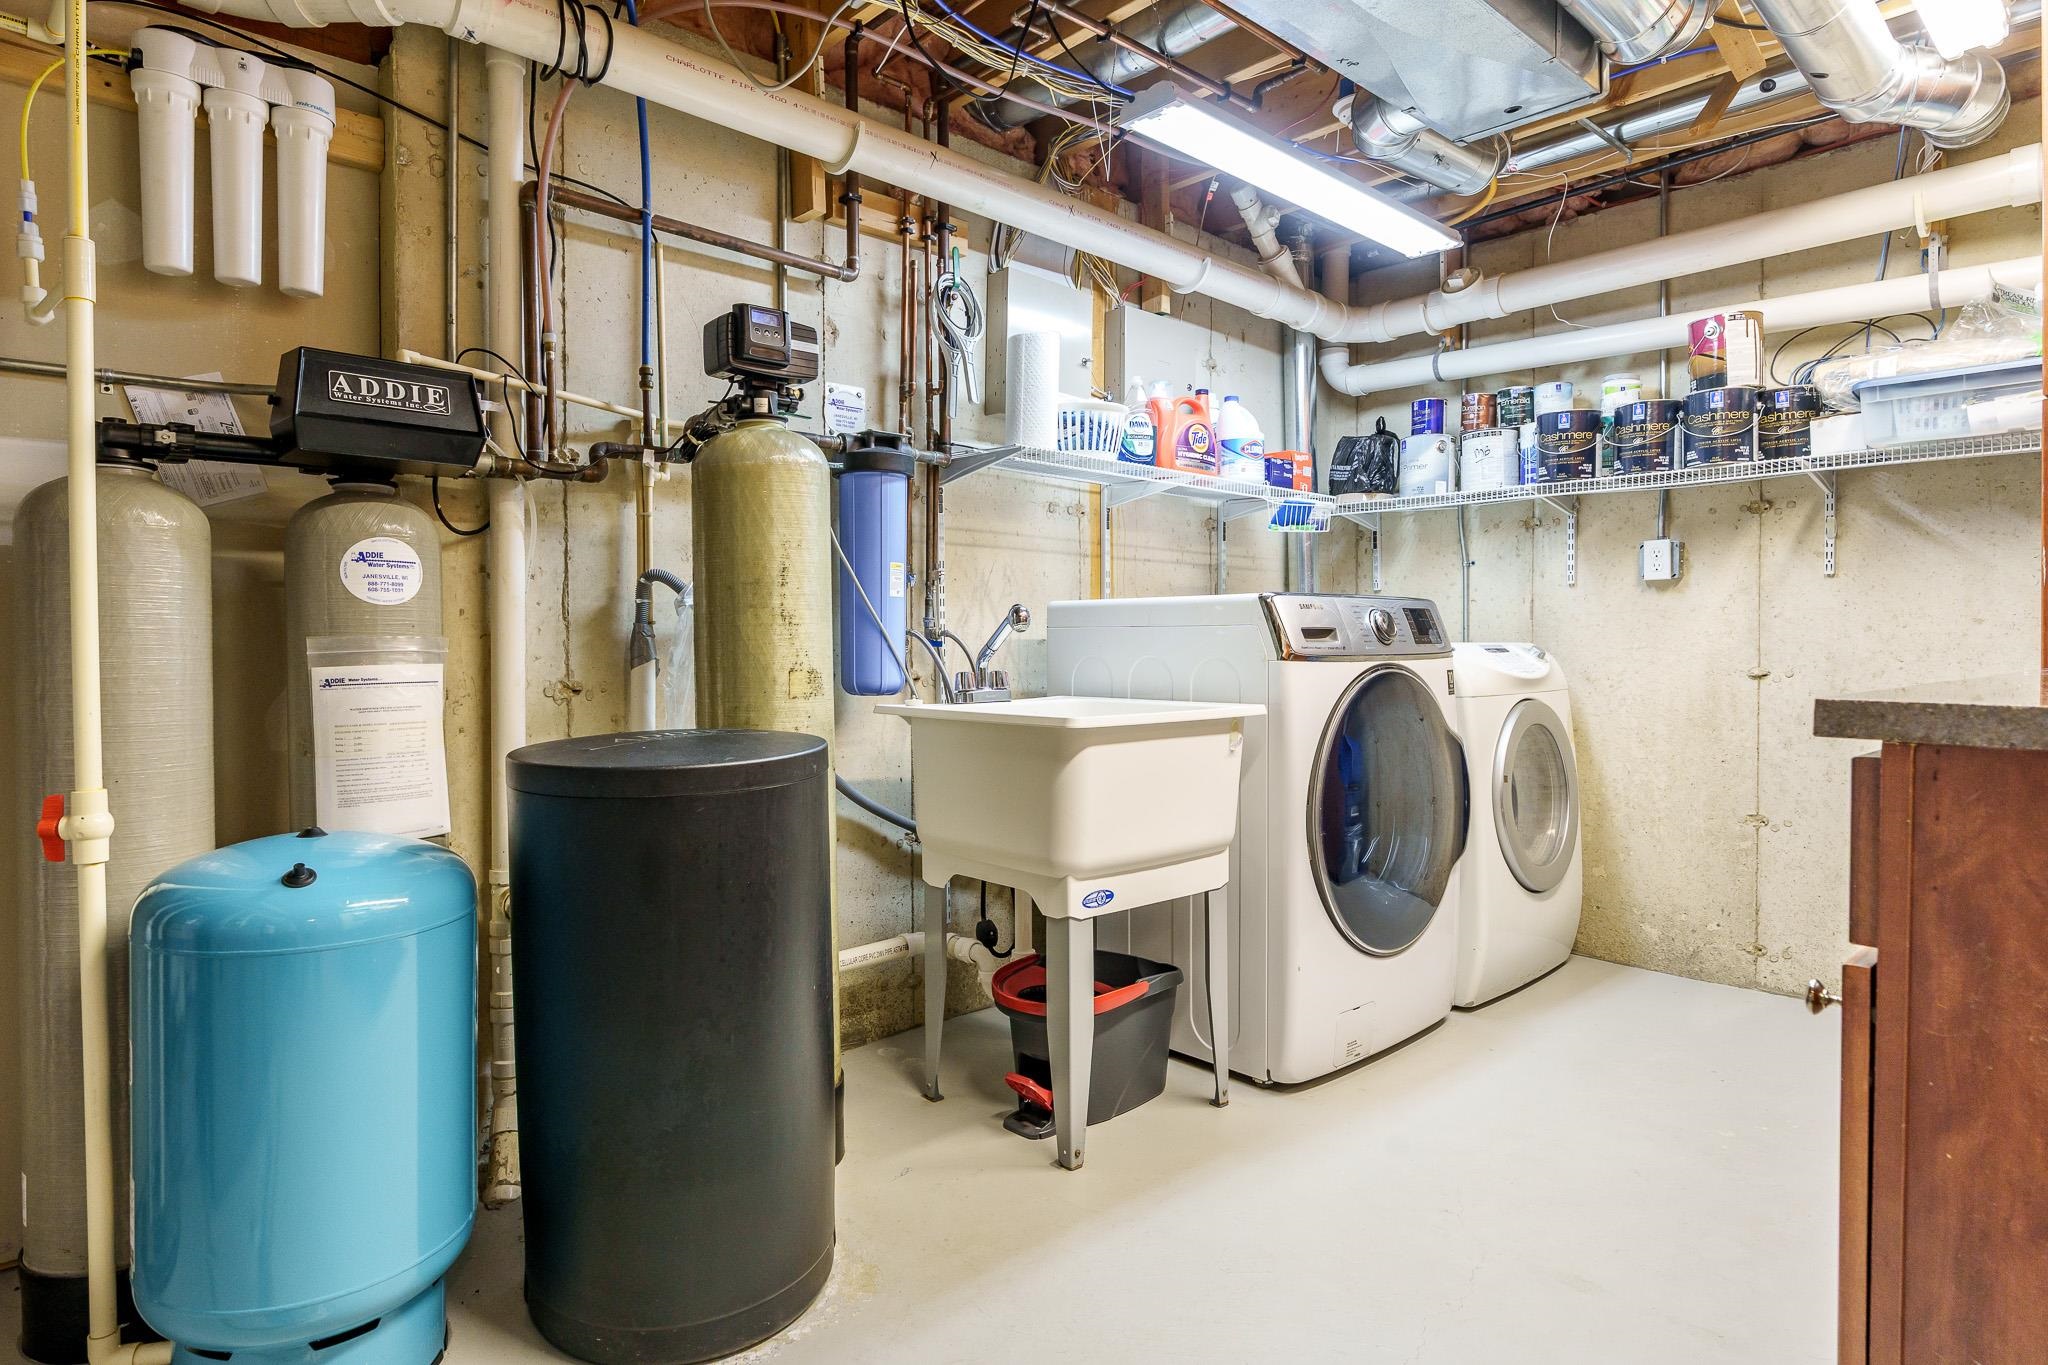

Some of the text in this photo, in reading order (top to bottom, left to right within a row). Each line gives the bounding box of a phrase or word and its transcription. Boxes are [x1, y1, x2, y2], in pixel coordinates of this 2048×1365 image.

[665, 54, 726, 81] CHARLOTTE
[731, 79, 756, 93] PIPE
[762, 90, 787, 104] 7400
[332, 374, 445, 407] ADDIE
[333, 391, 423, 410] Water Systems Inc.
[1129, 420, 1149, 428] DAWN
[1688, 410, 1750, 425] Cashmere
[1760, 410, 1816, 424] ashmere
[1615, 422, 1670, 436] Cashmere
[1191, 431, 1208, 446] Tide
[1540, 431, 1593, 443] Cashmere
[358, 551, 384, 563] ADDIE
